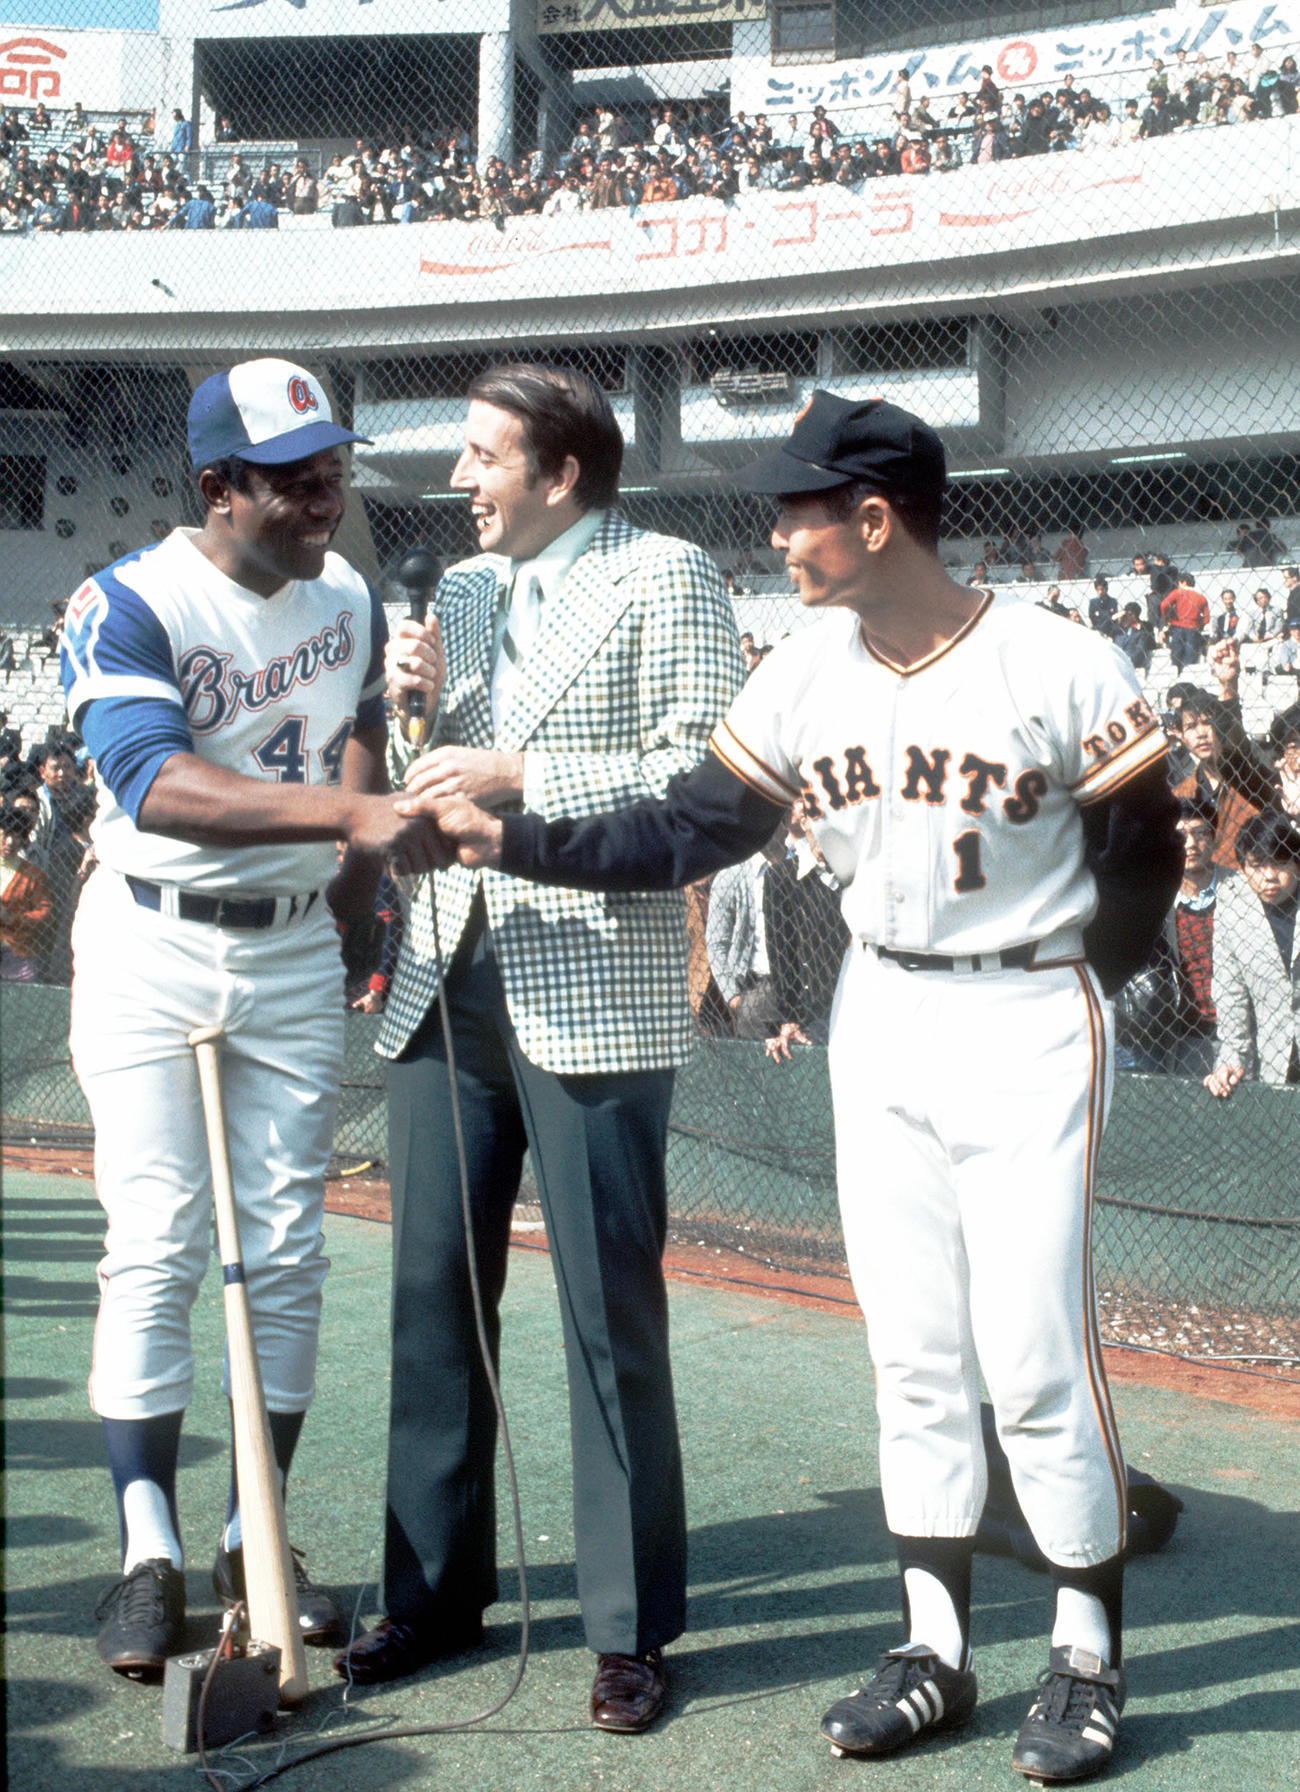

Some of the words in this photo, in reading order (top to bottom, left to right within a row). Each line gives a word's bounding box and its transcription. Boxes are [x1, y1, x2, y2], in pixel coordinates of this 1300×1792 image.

[0, 37, 67, 100] 命
[1053, 4, 1291, 72] ニッポンハム
[177, 611, 354, 737] Braves
[252, 714, 356, 785] 44
[953, 828, 987, 893] 1
